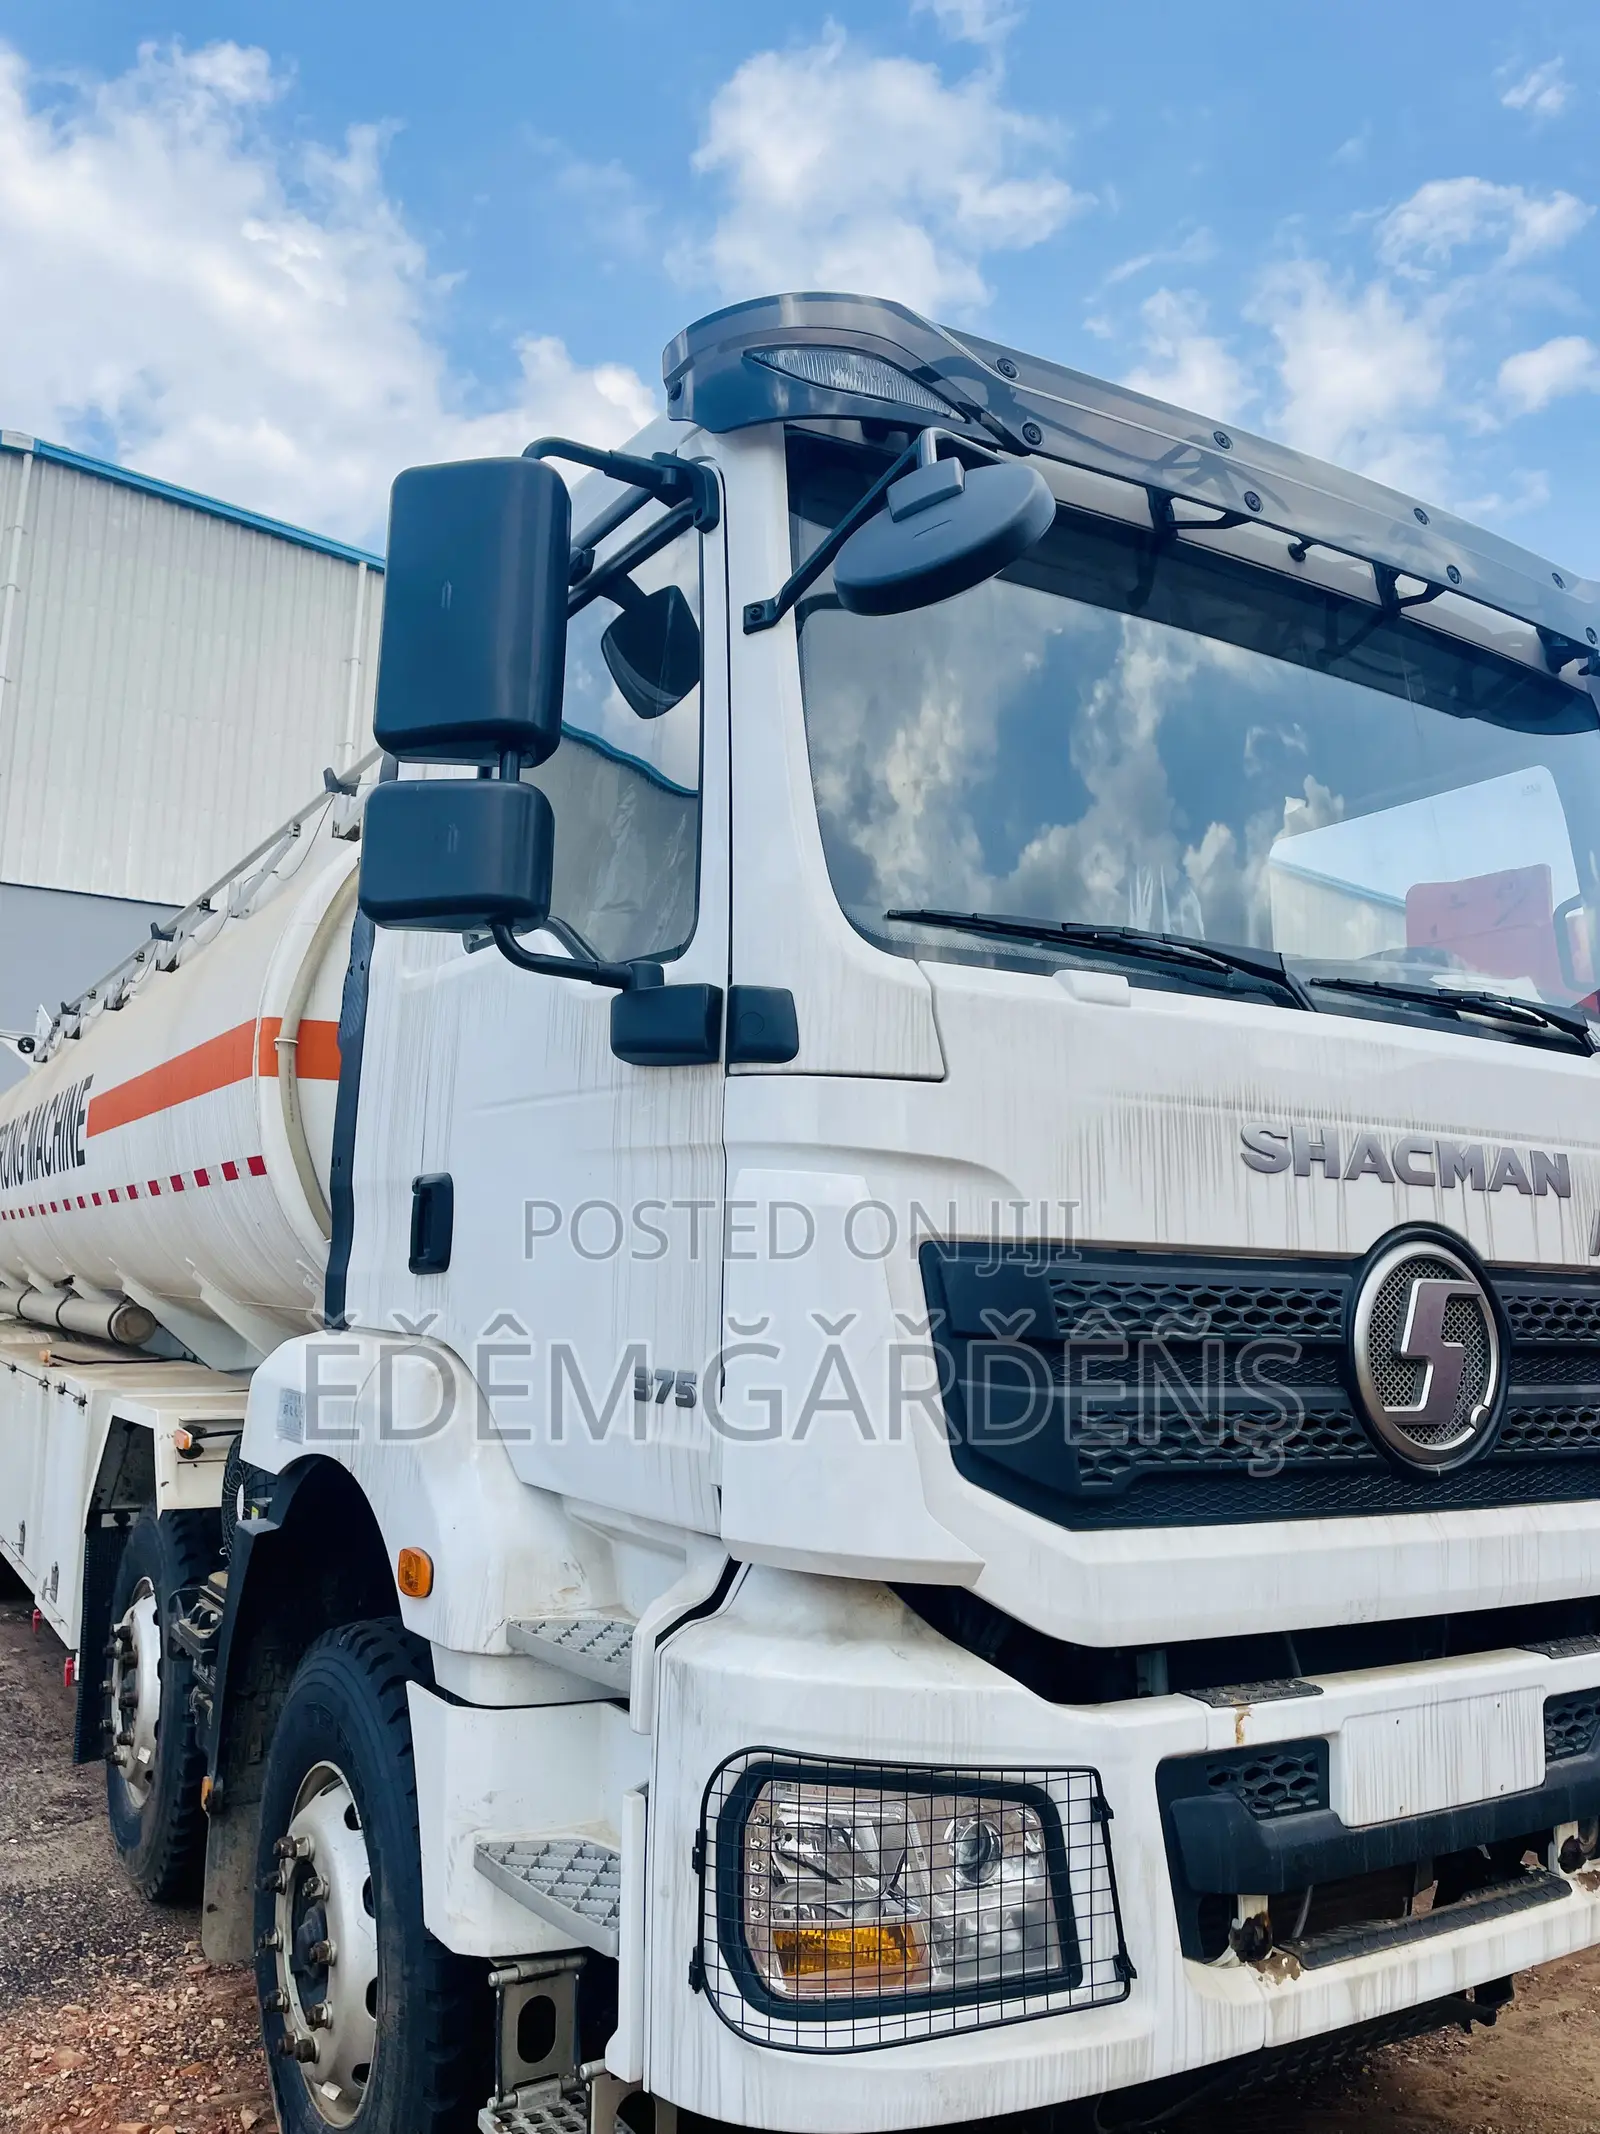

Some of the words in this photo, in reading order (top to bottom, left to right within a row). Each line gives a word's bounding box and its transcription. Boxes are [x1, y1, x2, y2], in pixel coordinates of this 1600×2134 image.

[27, 1073, 95, 1182] MACHINE
[1240, 1121, 1572, 1199] SHACMAN
[633, 1366, 698, 1409] 375
